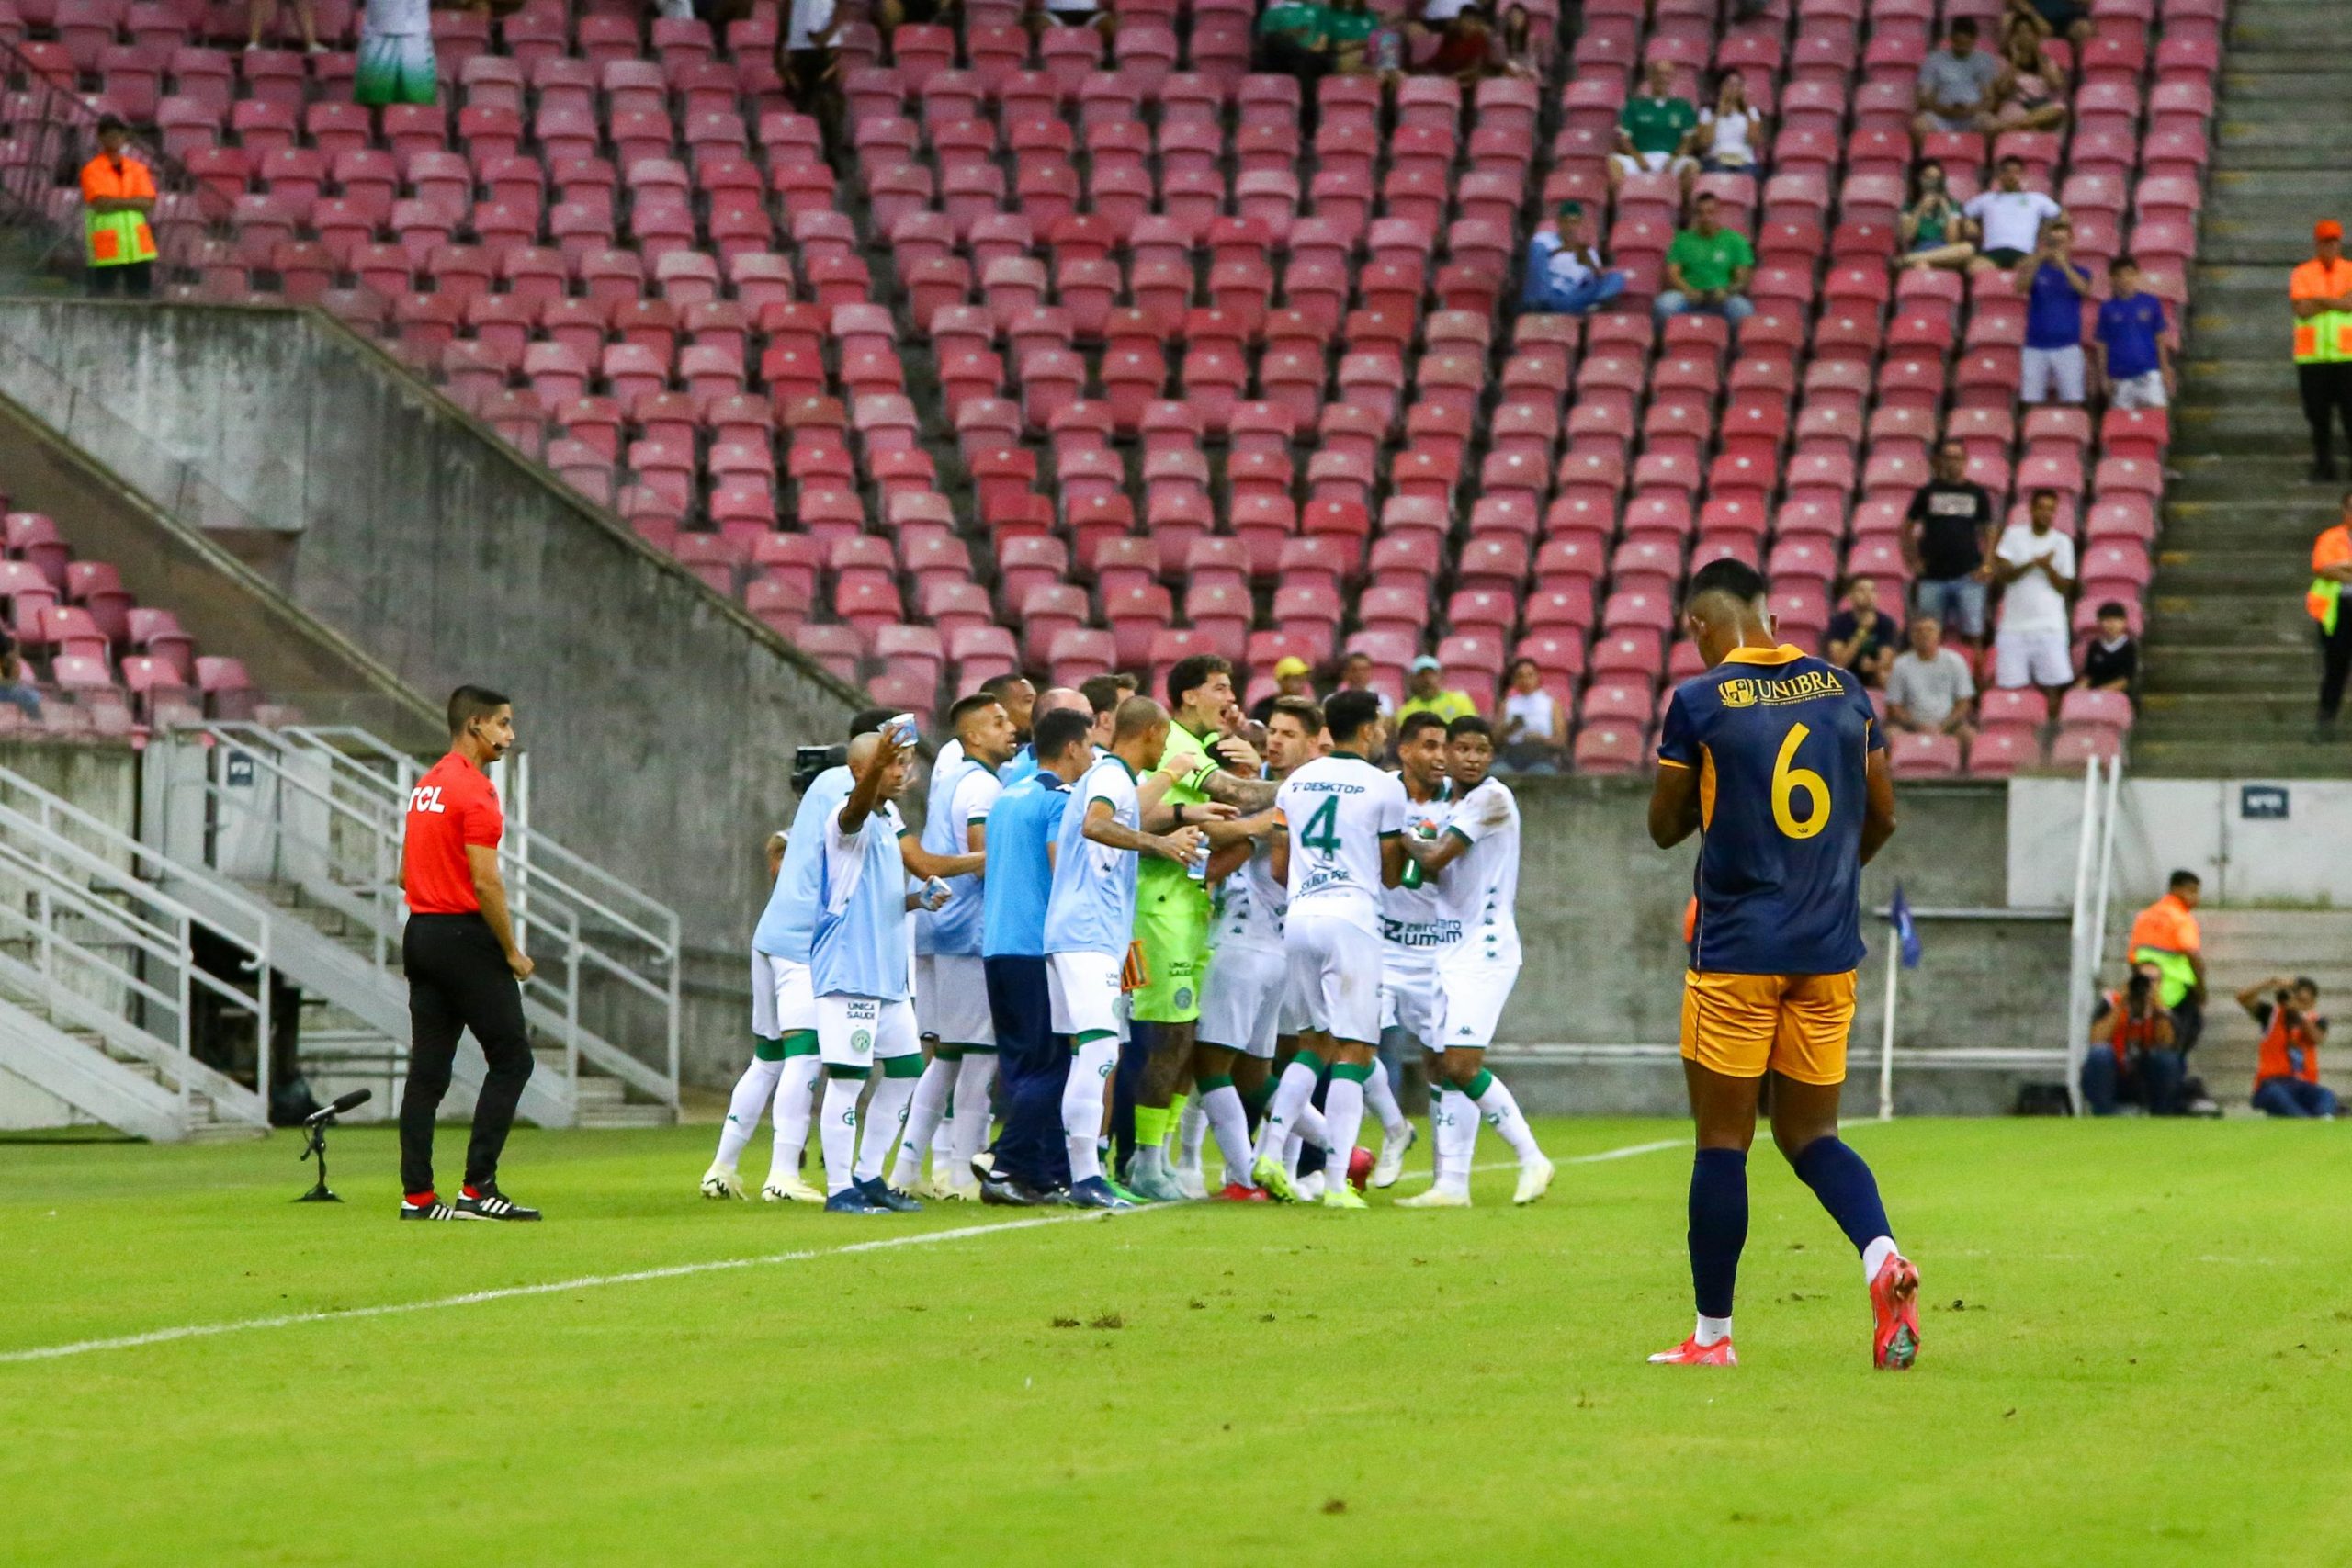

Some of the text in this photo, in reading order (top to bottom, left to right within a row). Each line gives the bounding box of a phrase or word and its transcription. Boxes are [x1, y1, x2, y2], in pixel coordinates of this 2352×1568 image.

[1756, 671, 1843, 699] UNIBRA
[1303, 781, 1365, 795] DESKTOP
[1771, 722, 1831, 840] 6
[407, 785, 446, 814] TCL
[1300, 795, 1342, 862] 4
